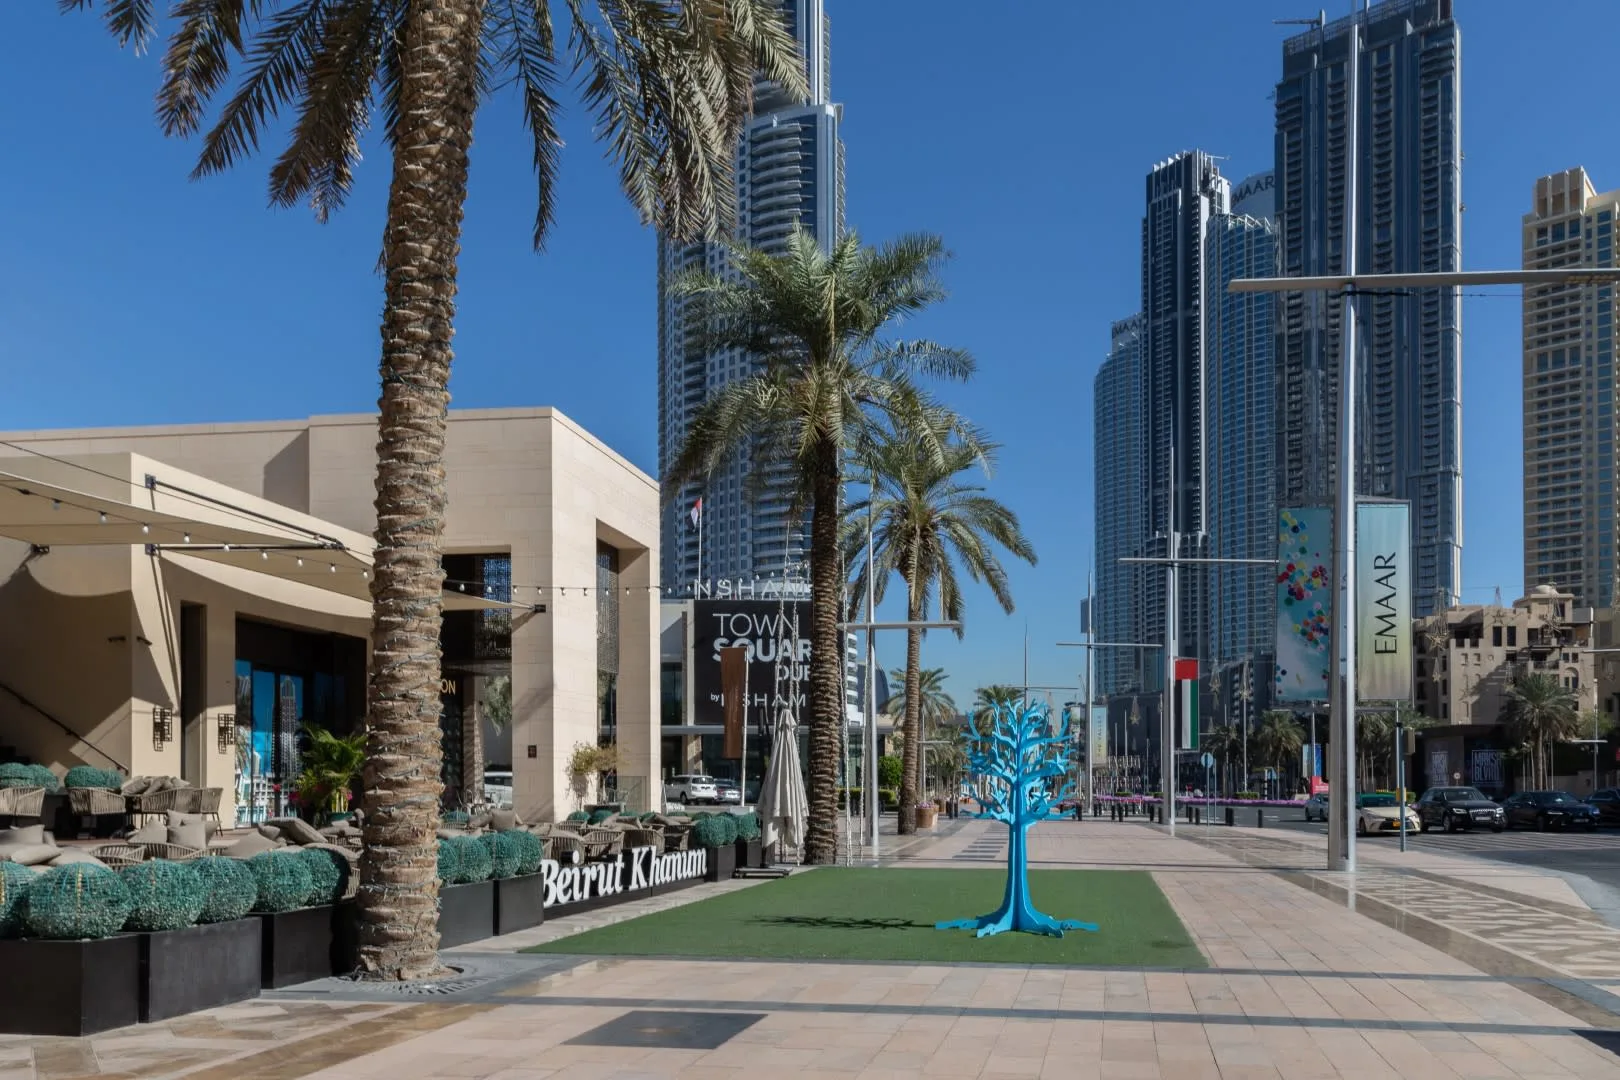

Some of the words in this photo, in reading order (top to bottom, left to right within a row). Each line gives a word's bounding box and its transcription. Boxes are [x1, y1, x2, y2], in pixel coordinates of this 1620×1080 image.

[1231, 175, 1276, 202] MAAR
[693, 578, 806, 600] NSHAM
[1374, 551, 1397, 655] EMAAR
[712, 613, 799, 636] TOWN
[713, 638, 812, 663] SQUAR
[710, 692, 720, 703] by
[540, 850, 624, 909] Beirut
[629, 845, 707, 892] Khanum
